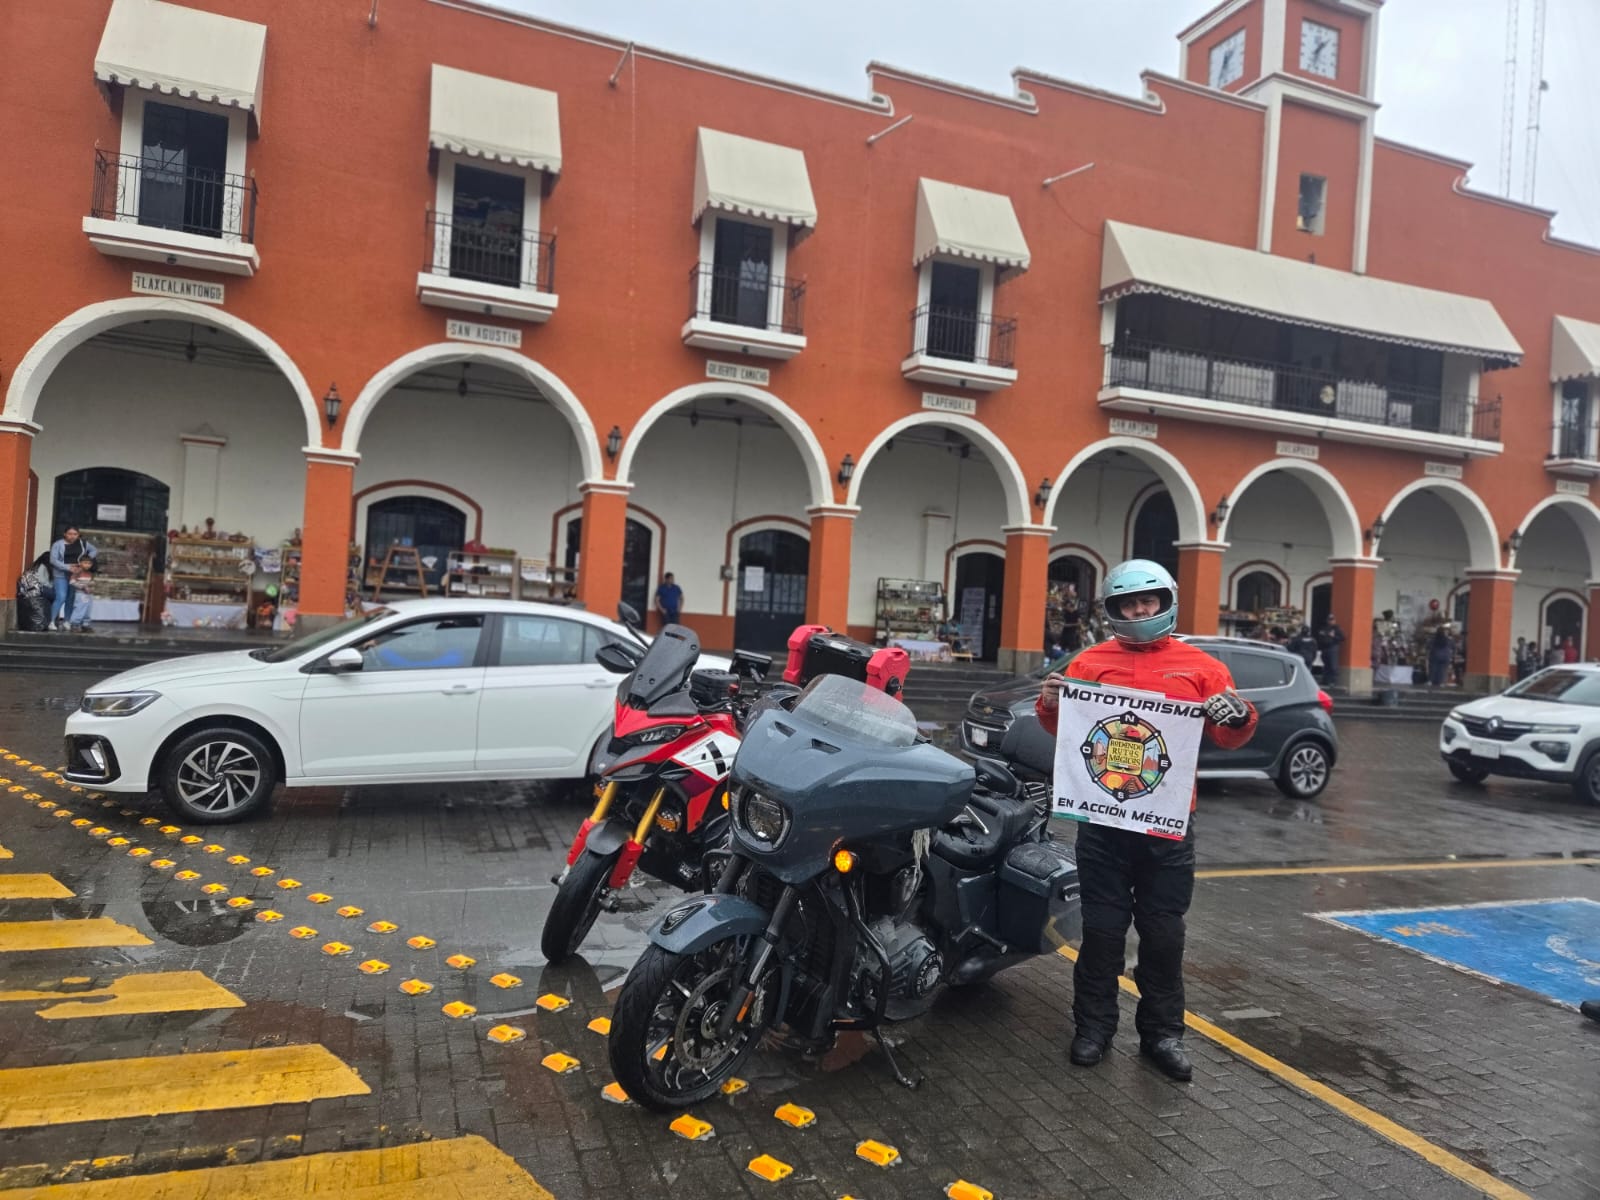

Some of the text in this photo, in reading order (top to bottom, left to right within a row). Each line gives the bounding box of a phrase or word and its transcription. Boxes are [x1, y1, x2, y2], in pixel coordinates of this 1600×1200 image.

[135, 275, 222, 300] TLAXCALANTONGO
[450, 322, 471, 337] SAN
[1062, 686, 1204, 719] MOTOTURISMO
[1112, 747, 1140, 758] RUTAS
[1057, 797, 1184, 829] EN ACCIÓN MÉXICO
